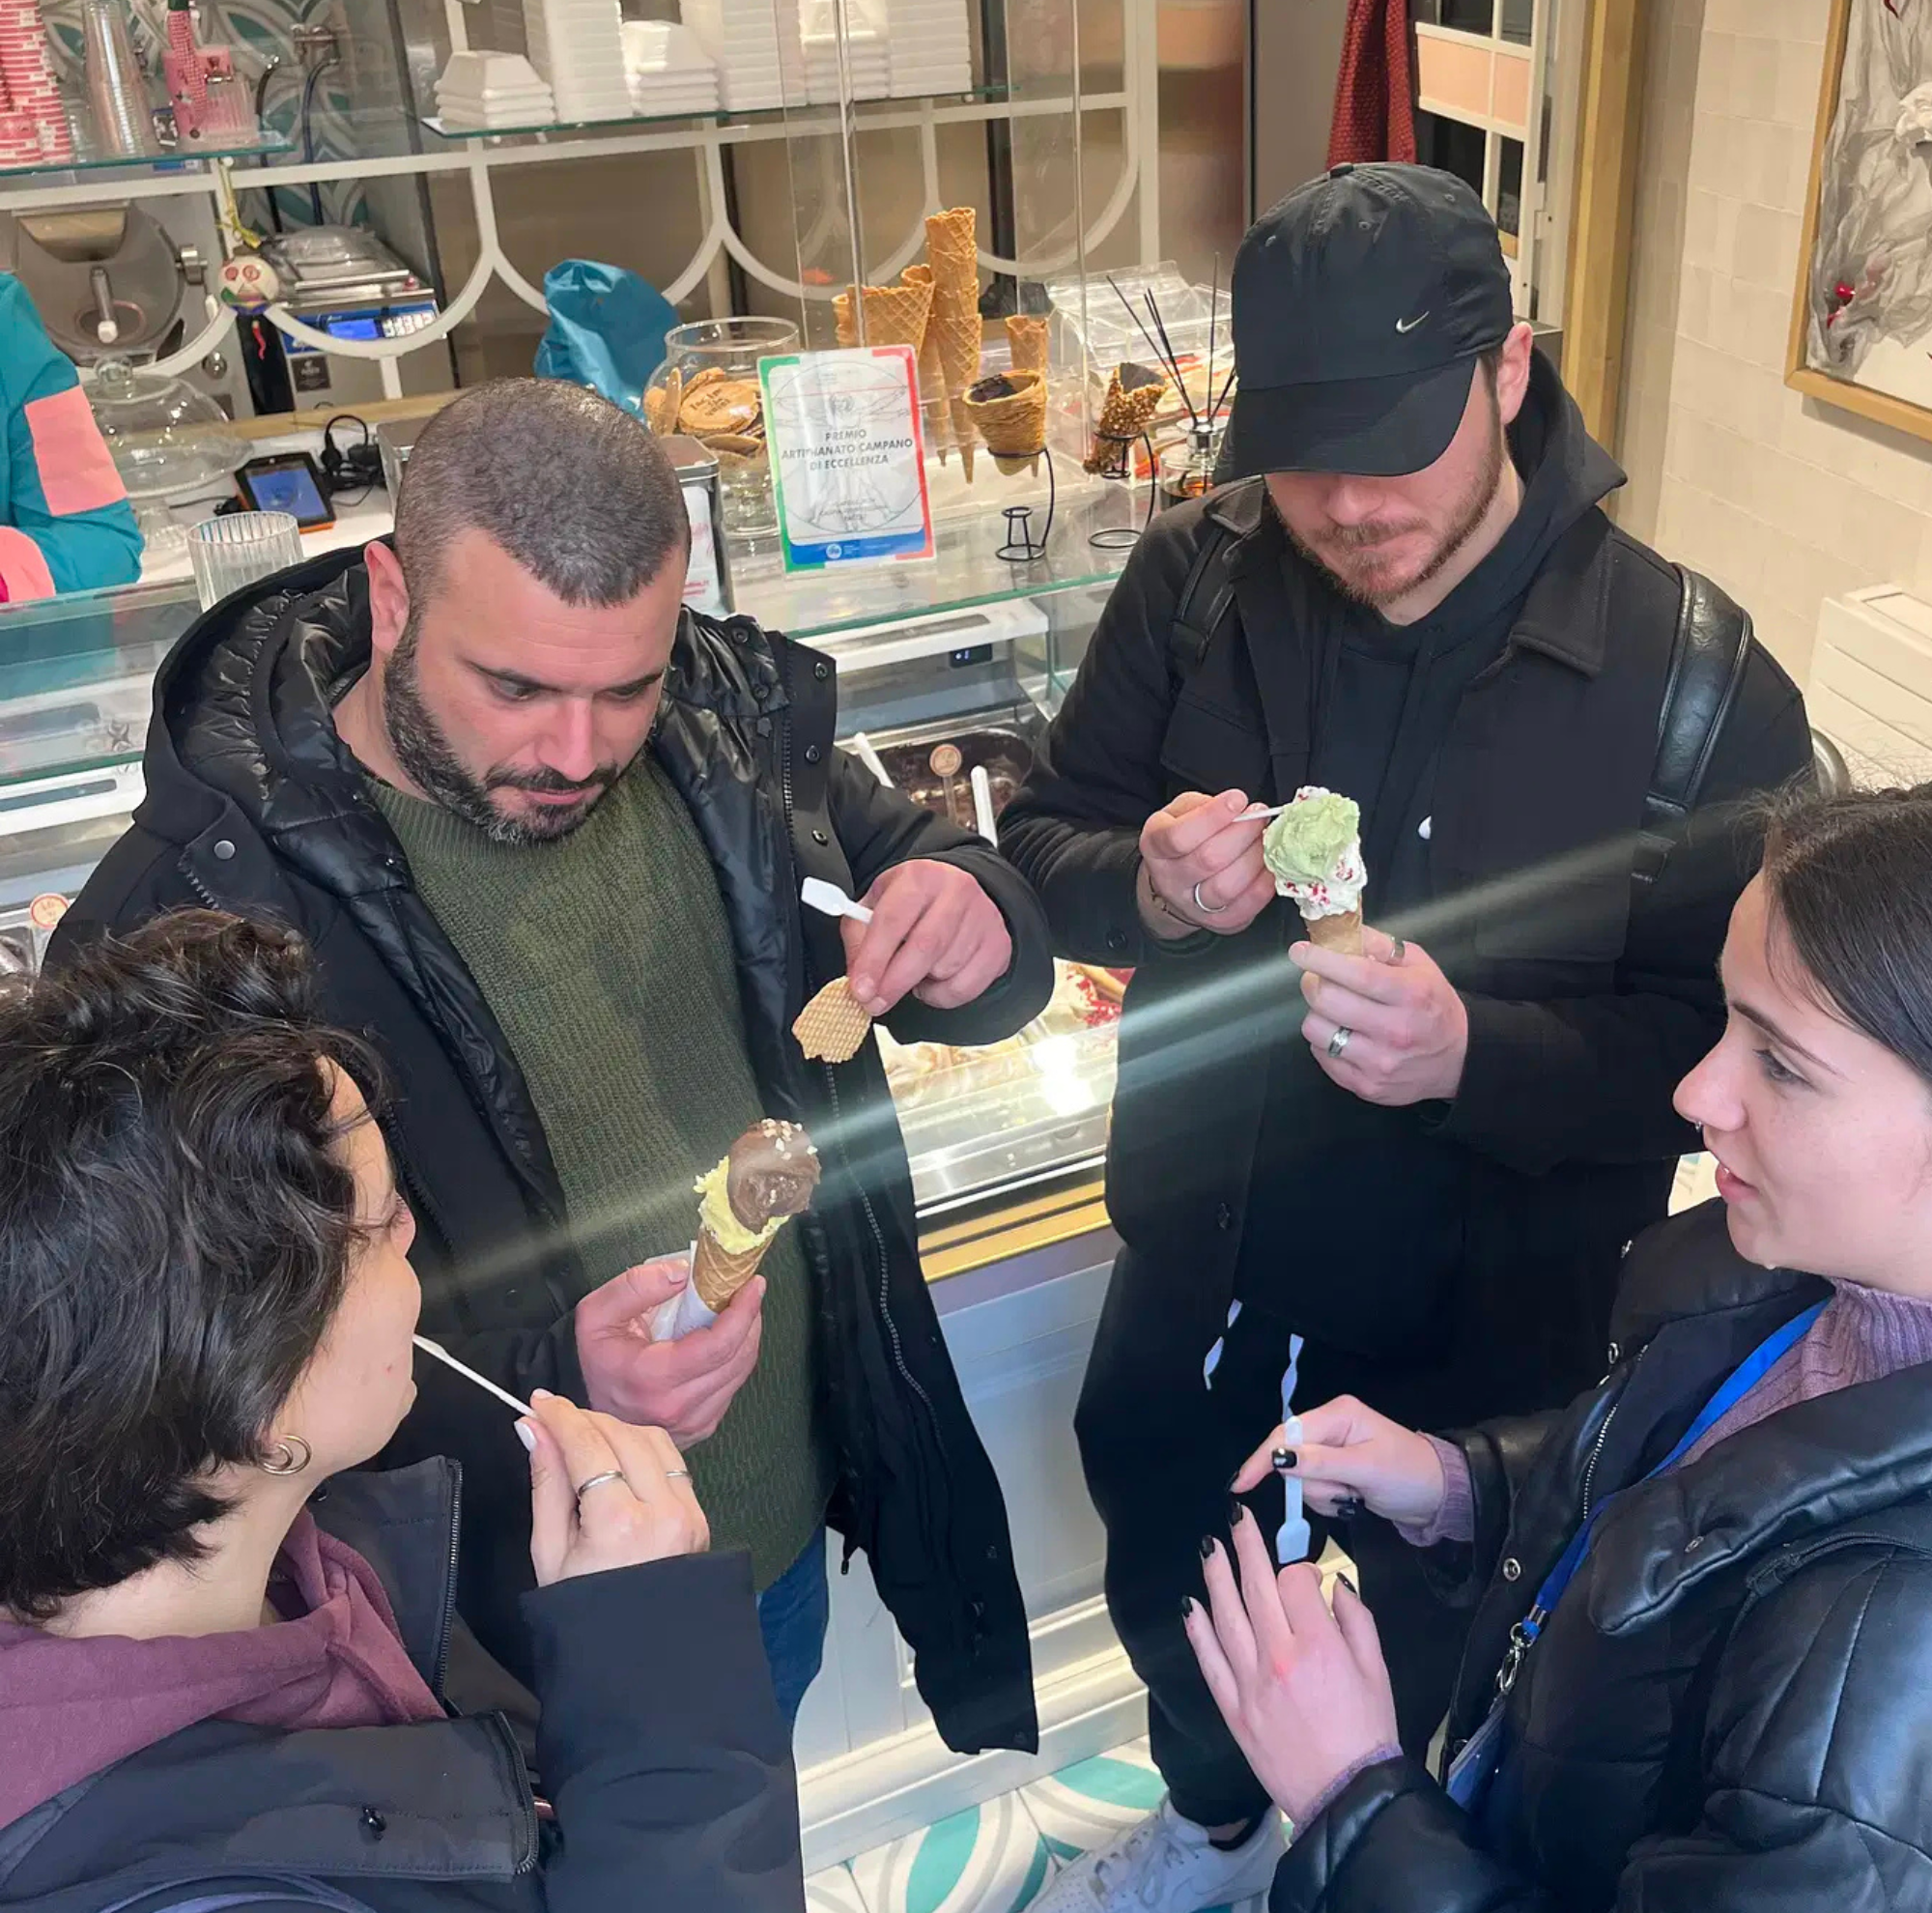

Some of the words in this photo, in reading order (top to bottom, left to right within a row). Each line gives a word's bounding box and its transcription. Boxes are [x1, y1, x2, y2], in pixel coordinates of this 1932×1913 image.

[825, 429, 867, 442] PREMIO
[858, 439, 913, 452] CAMPANO
[810, 462, 822, 471] DI
[825, 455, 889, 470] ECCELLENZA
